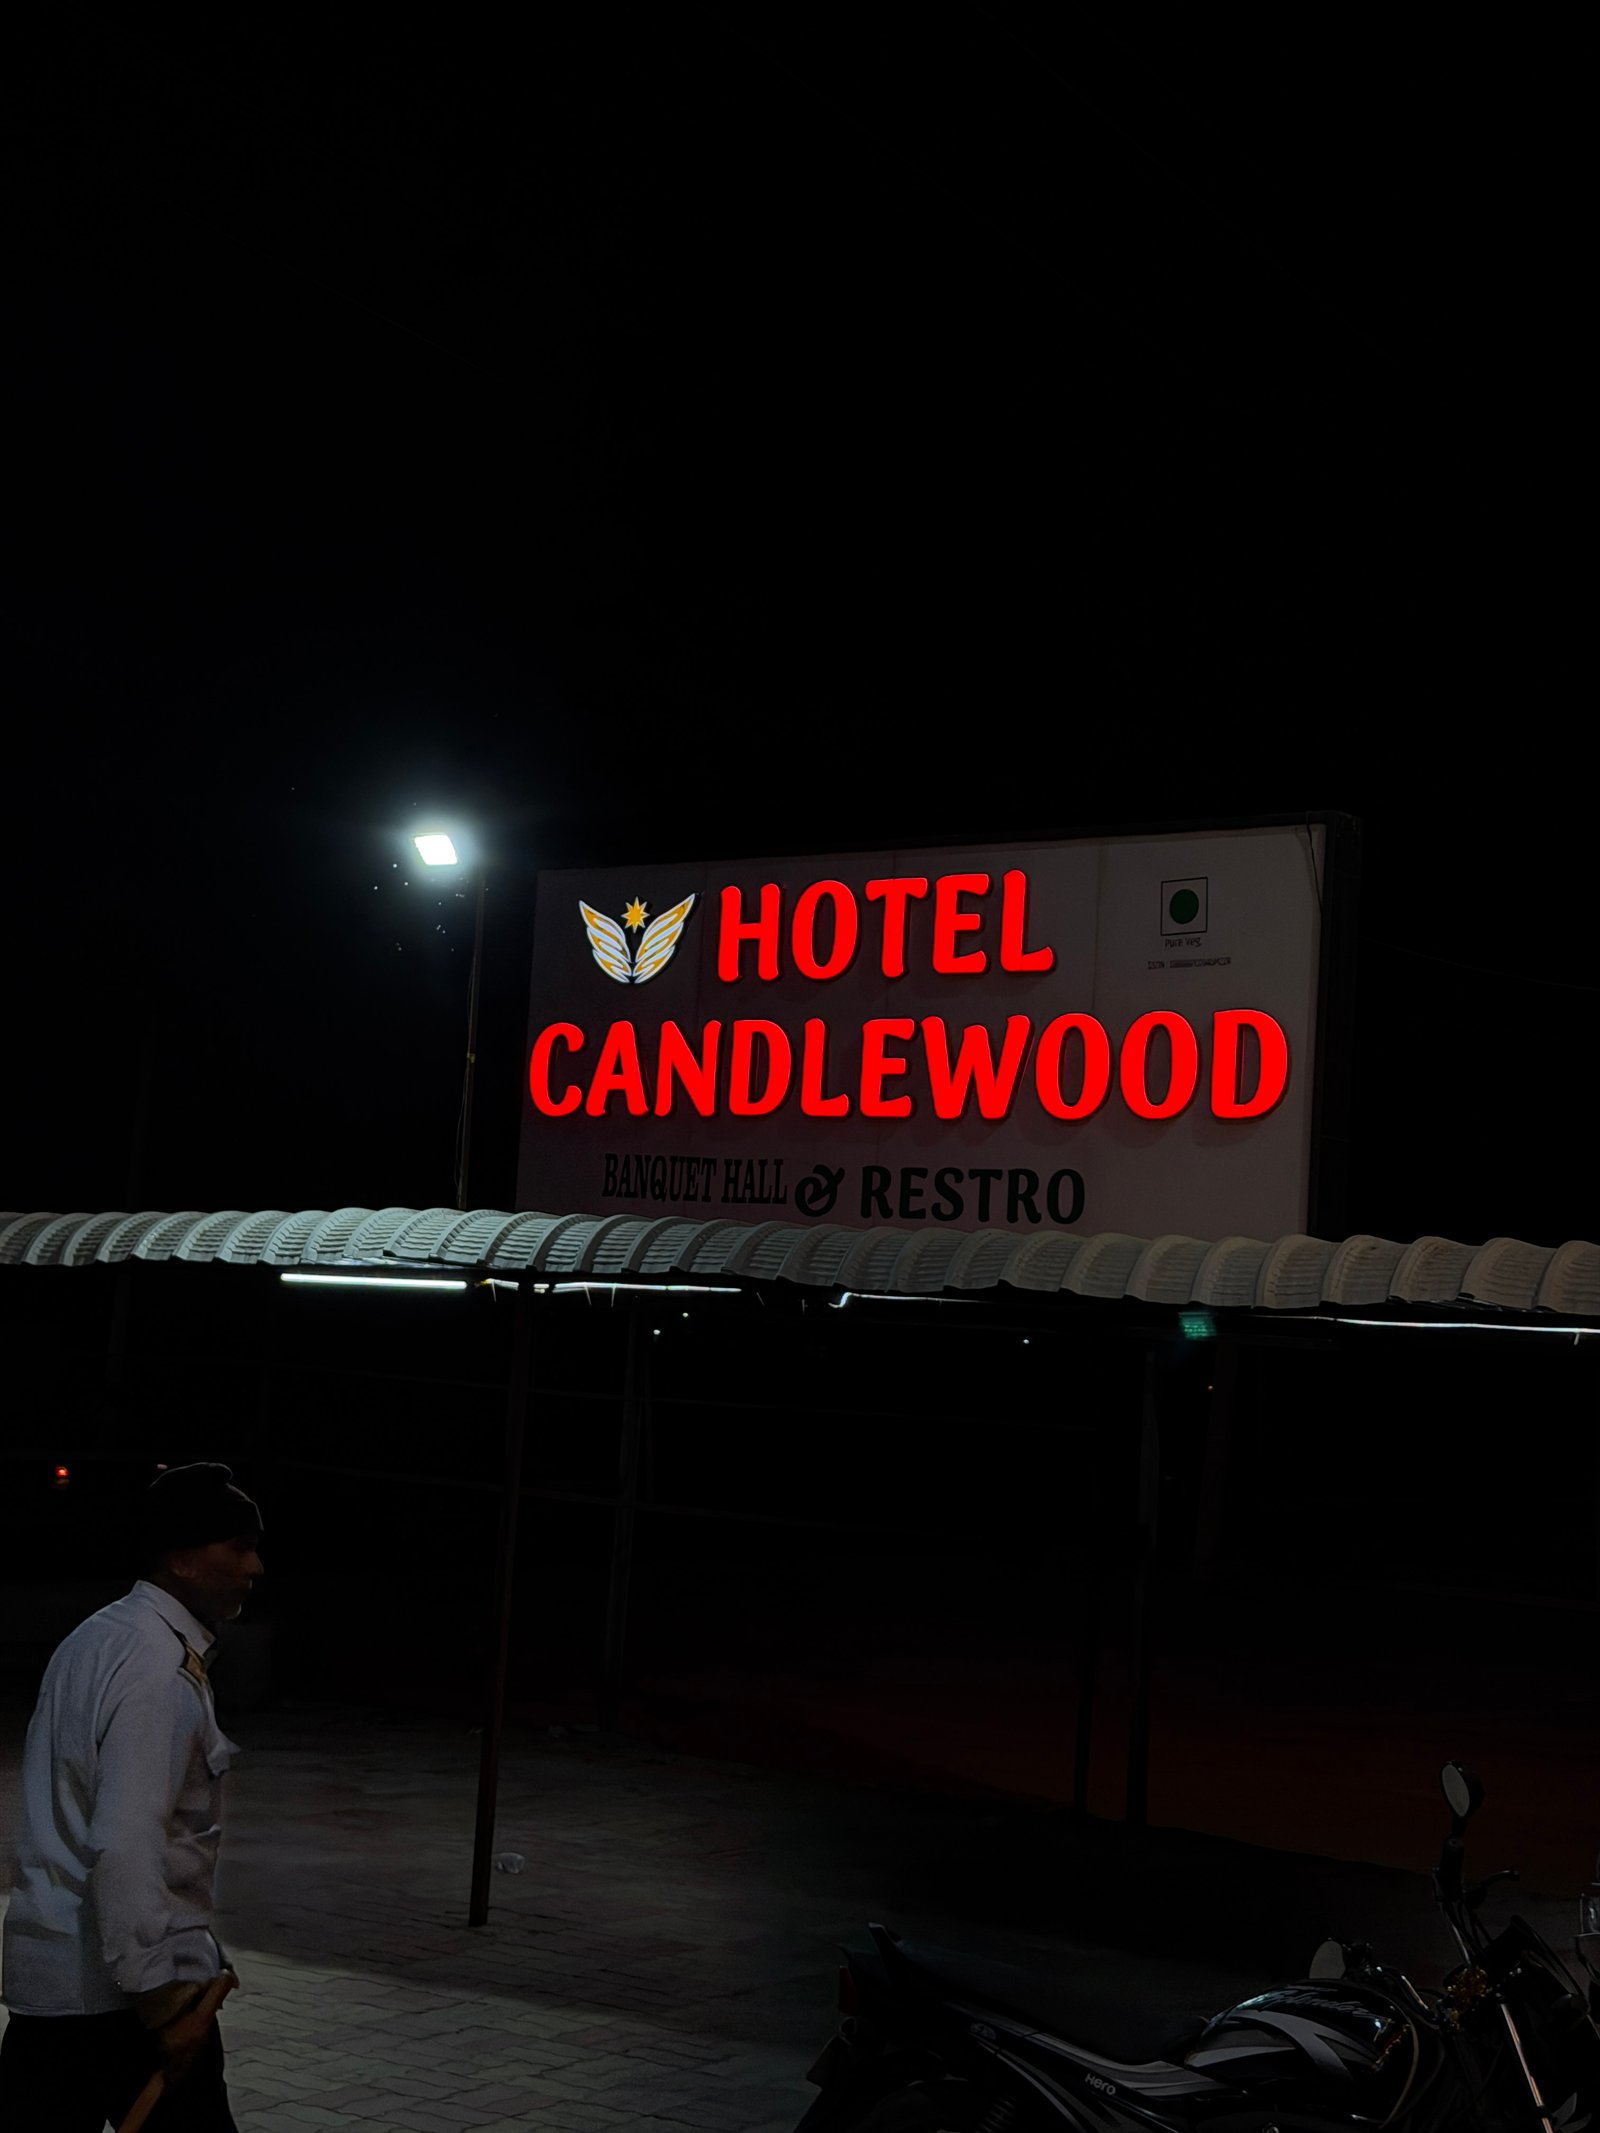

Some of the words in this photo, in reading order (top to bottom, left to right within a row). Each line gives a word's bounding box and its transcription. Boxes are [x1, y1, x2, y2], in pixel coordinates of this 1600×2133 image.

[717, 869, 1055, 982] HOTEL
[529, 1008, 1290, 1121] CANDLEWOOD
[601, 1152, 717, 1202] BANQUET
[721, 1158, 788, 1204] HALL
[795, 1164, 846, 1217] &
[860, 1165, 1085, 1224] RESTRO
[1084, 2073, 1117, 2096] Hero
